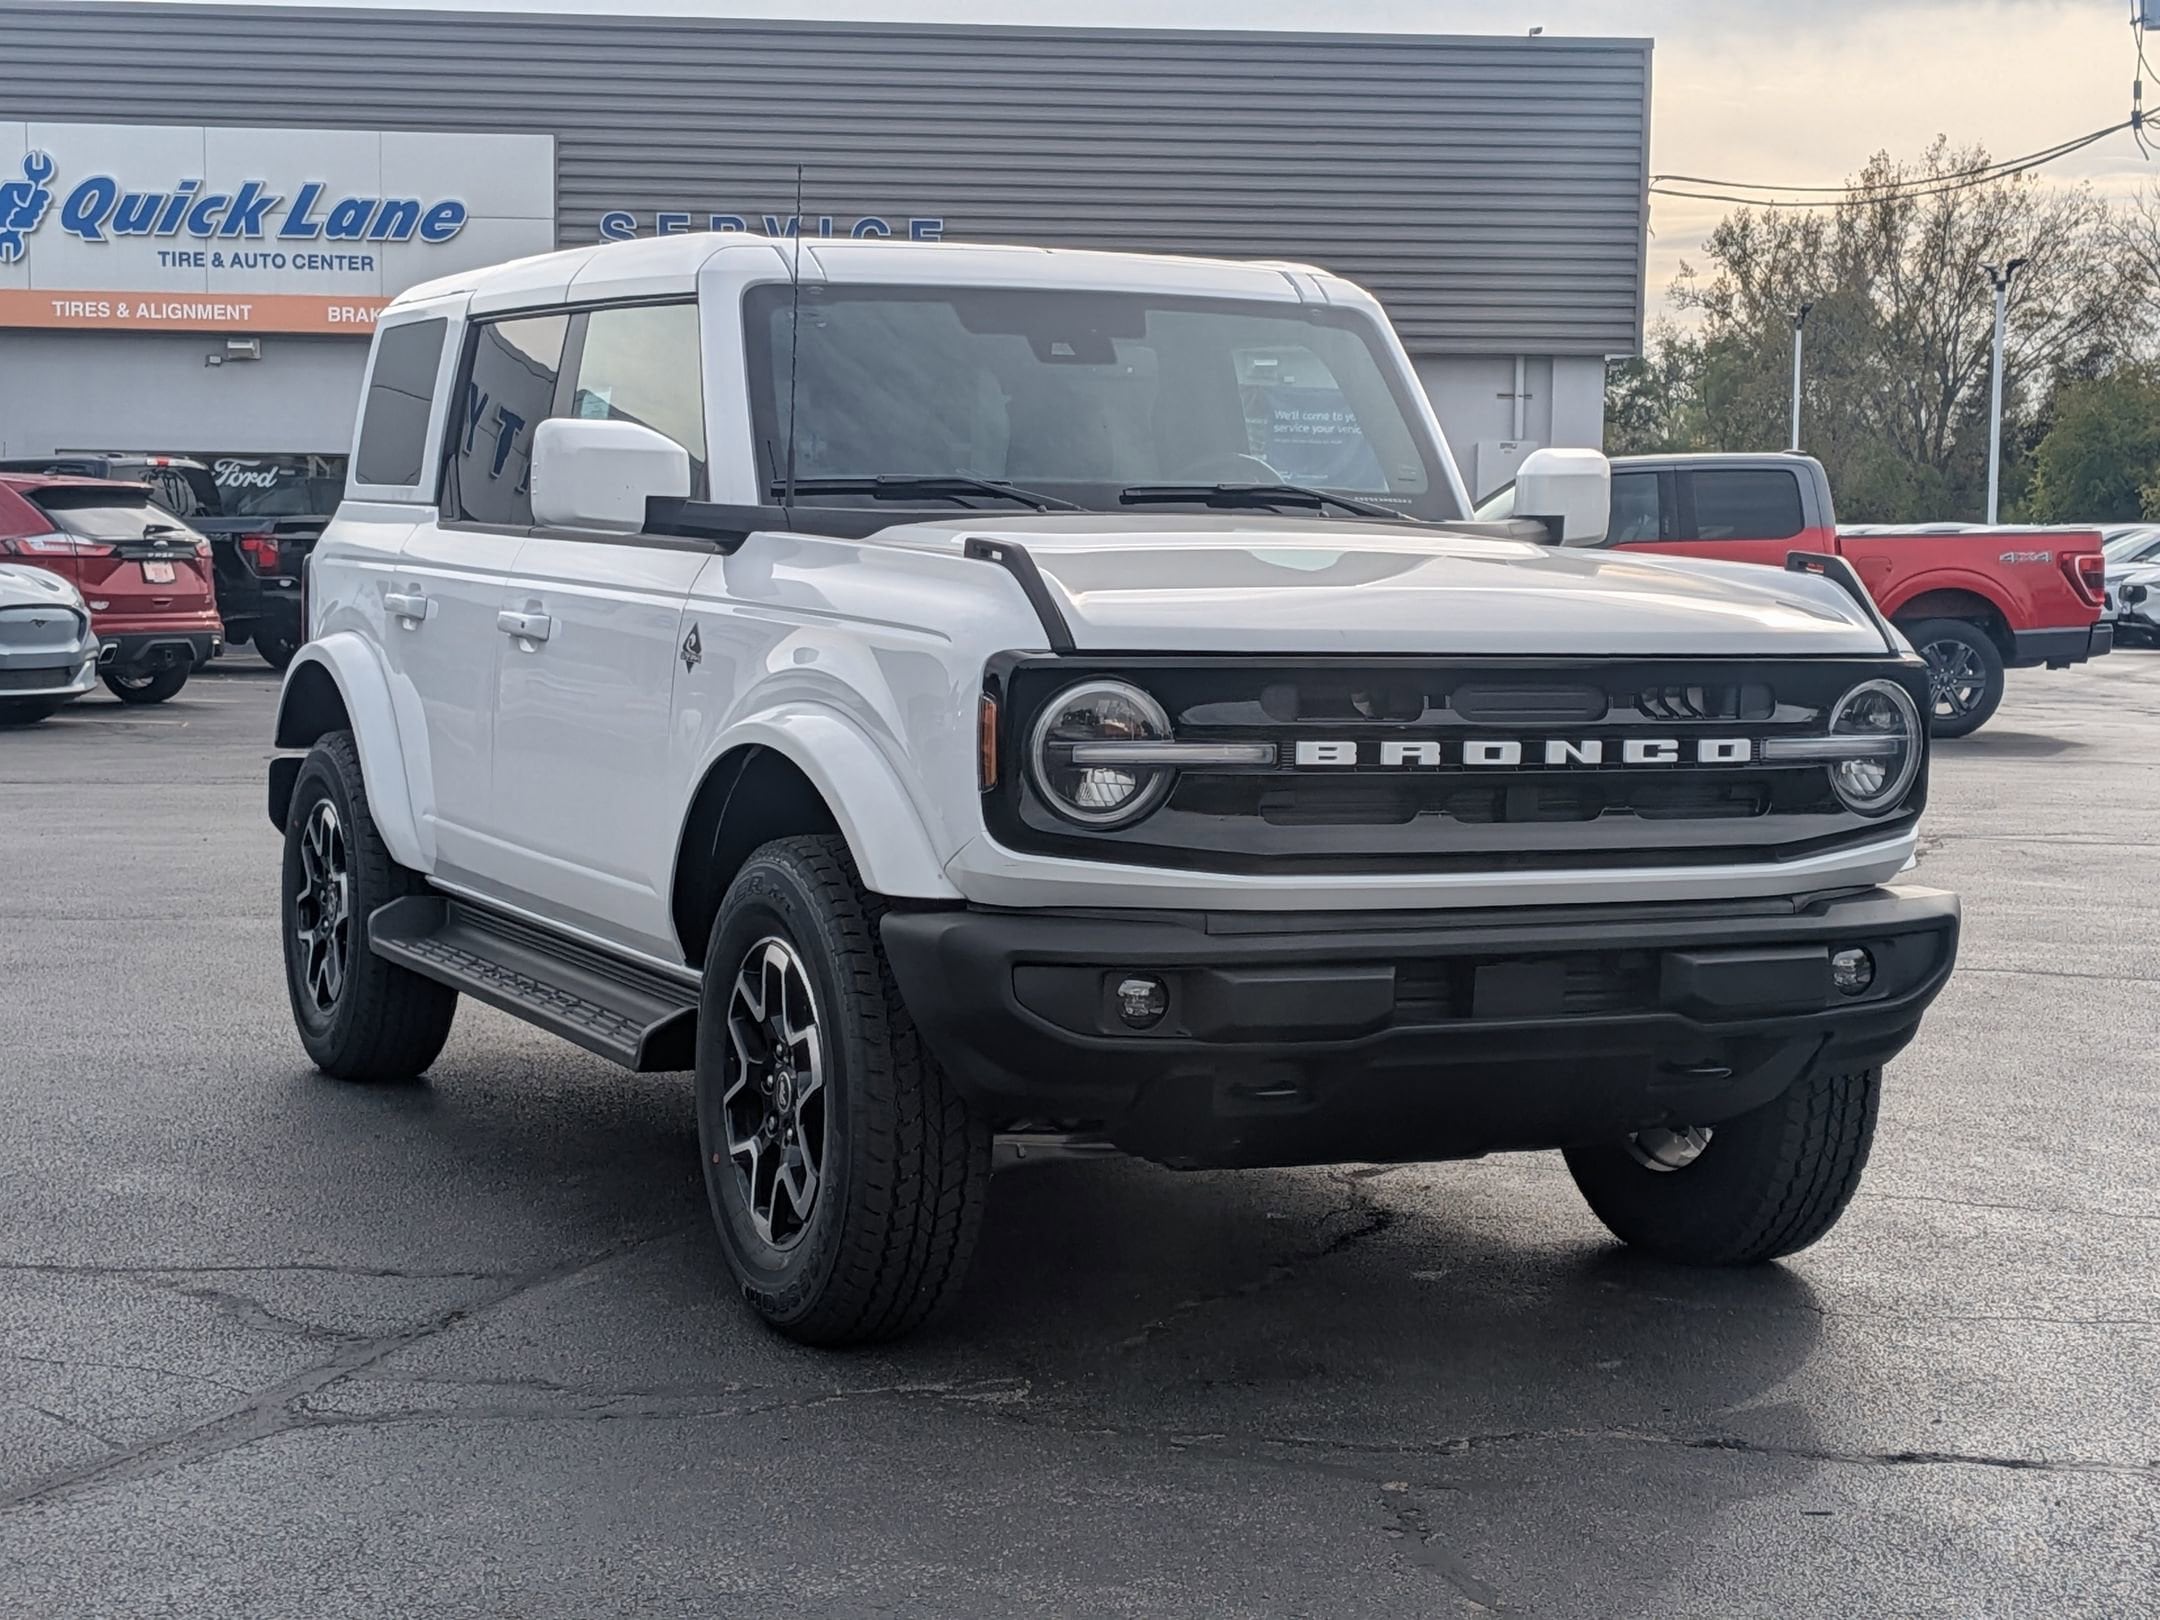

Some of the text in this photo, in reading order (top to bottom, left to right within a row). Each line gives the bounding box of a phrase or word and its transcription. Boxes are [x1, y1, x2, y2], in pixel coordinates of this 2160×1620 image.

[60, 174, 468, 243] Quick Lane
[158, 251, 374, 271] TIRE & AUTO CENTER
[52, 301, 252, 320] TIRES & ALIGNMENT
[1274, 410, 1299, 421] We'll
[1302, 411, 1330, 421] come
[1333, 411, 1343, 421] to
[1273, 423, 1310, 433] service
[1312, 424, 1335, 435] your
[212, 458, 279, 488] Ford
[1296, 737, 1751, 766] BRONCO
